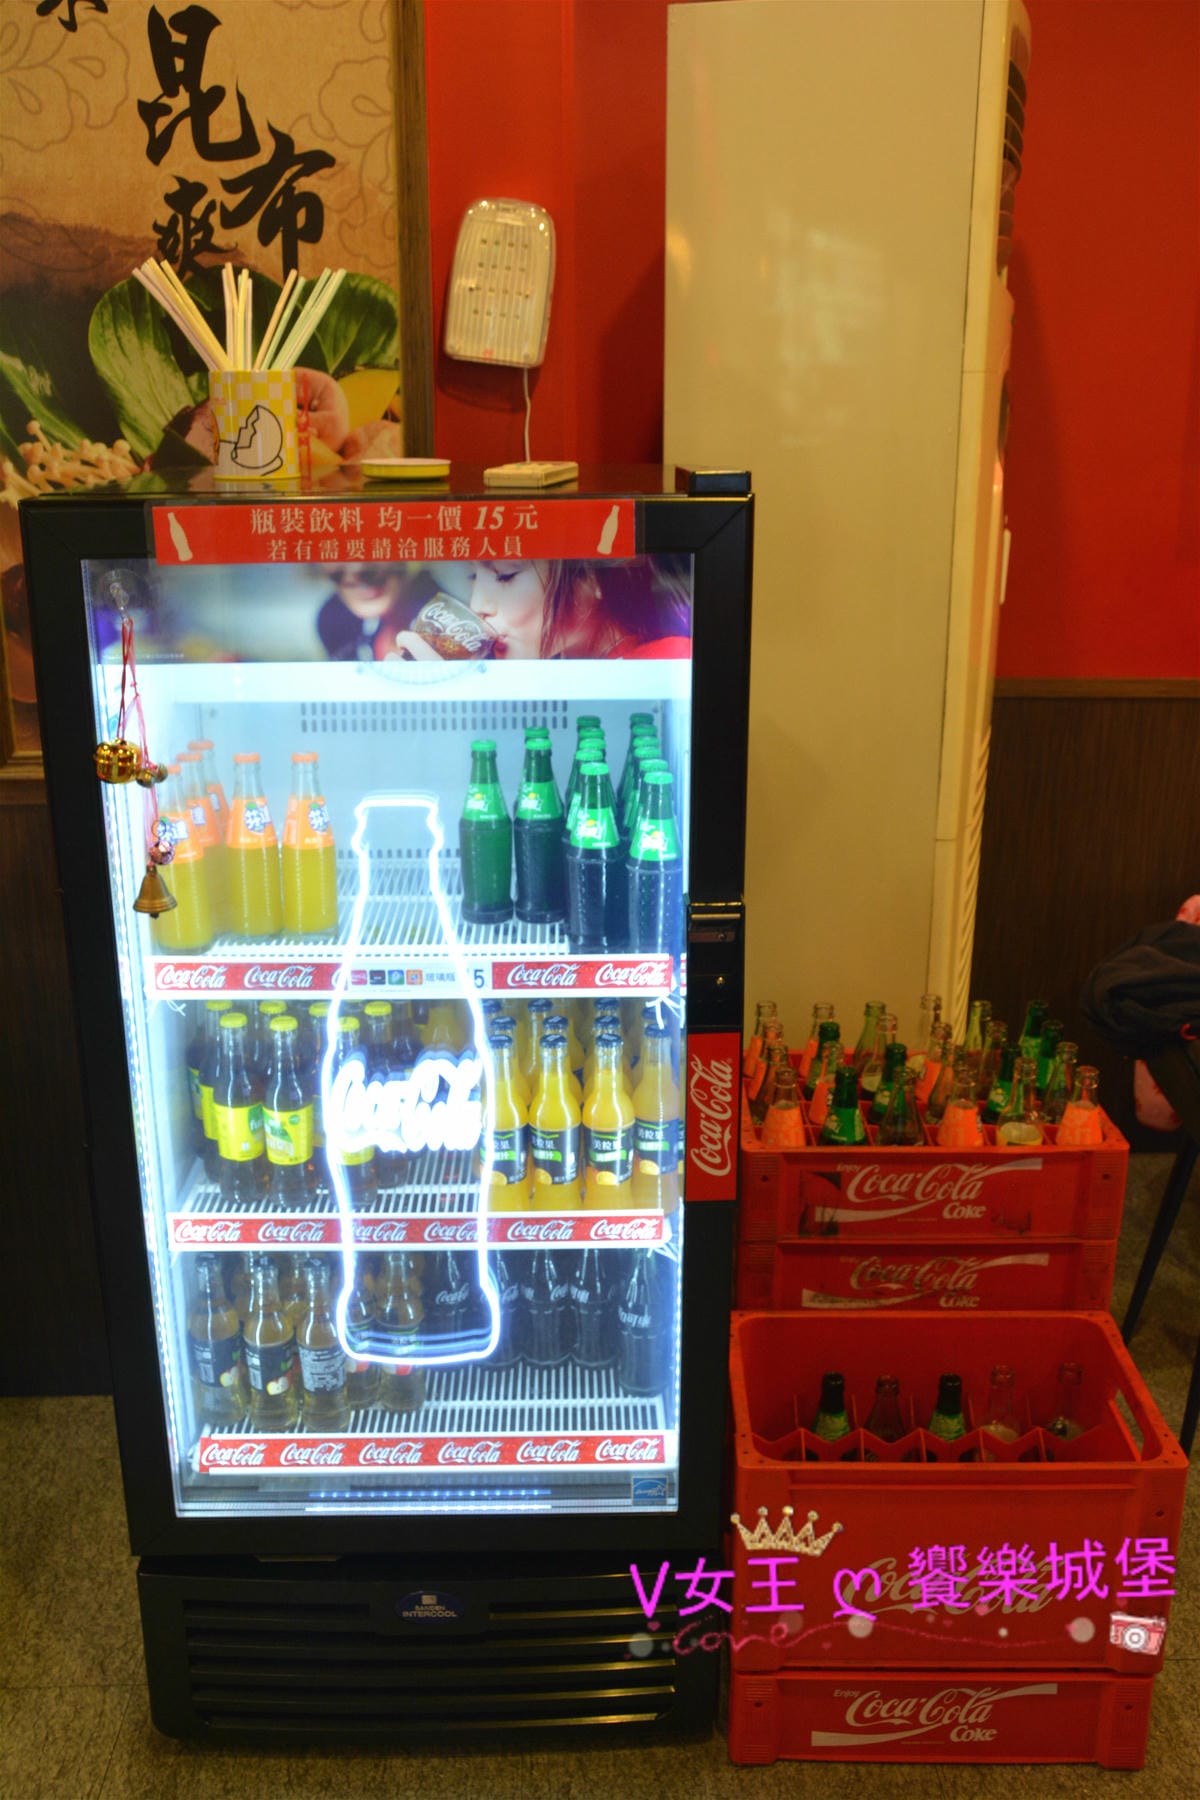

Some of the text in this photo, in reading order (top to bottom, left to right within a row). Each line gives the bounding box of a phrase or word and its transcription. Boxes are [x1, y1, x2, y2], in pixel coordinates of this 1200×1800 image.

[251, 504, 538, 534] 瓶裝飲料 均一價 15 元
[267, 535, 523, 561] 若有需要請洽服務人員
[157, 964, 227, 989] Coca-Cola
[243, 964, 316, 989] Coca-Cola
[507, 963, 580, 986] Coca-Cola
[594, 961, 670, 986] Coca-Cola
[691, 1053, 732, 1177] Coca-Cola
[846, 1163, 990, 1203] Coca-Cola
[942, 1202, 987, 1219] Coke
[174, 1220, 244, 1243] Coca-Cola
[257, 1221, 326, 1242] Coca-Cola
[507, 1219, 577, 1241] Coca-Cola
[590, 1217, 661, 1240] Coca-Cola
[850, 1255, 982, 1291] Coca-Cola
[939, 1292, 981, 1308] Coke
[201, 1437, 661, 1466] Coca-Cola Coca-Cola Coca-Cola Coca-Cola Coca-Cola Coca-Cola
[833, 1689, 860, 1698] Enjoy
[845, 1687, 1000, 1727] Coca-Cola
[949, 1724, 998, 1742] Coke
